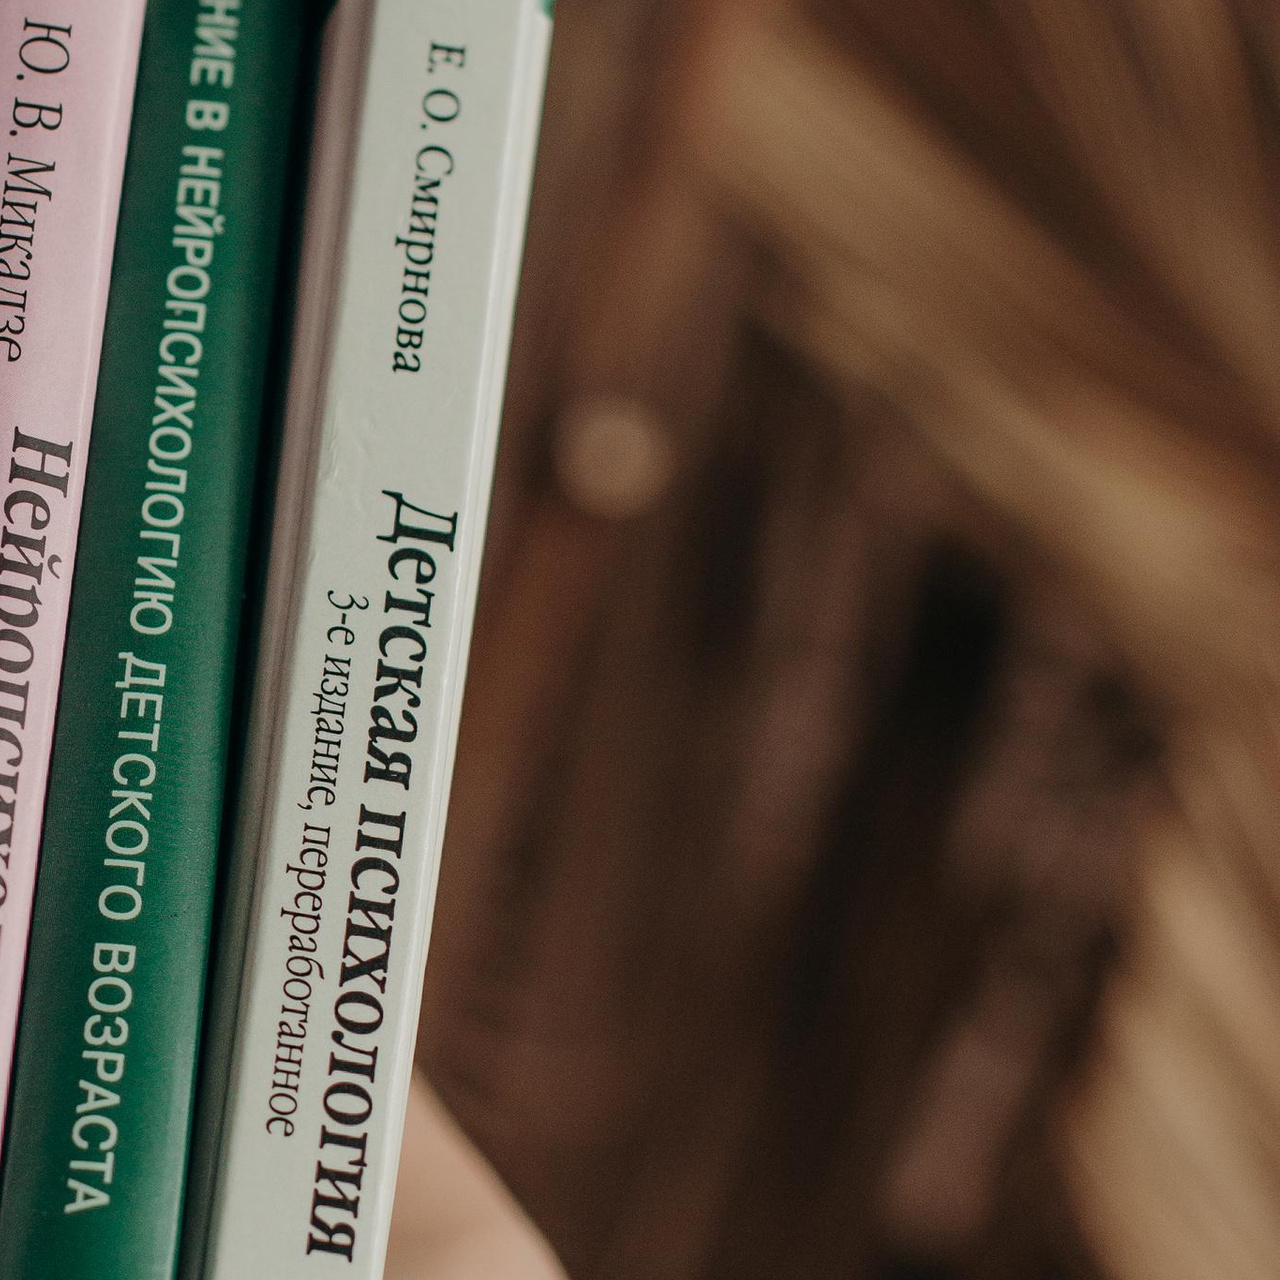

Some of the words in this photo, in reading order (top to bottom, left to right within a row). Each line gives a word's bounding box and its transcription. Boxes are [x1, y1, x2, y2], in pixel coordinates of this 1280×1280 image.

[9, 97, 63, 137] В.
[15, 17, 72, 81] Ю.
[185, 99, 230, 131] В
[421, 88, 460, 130] О.
[427, 41, 466, 73] Е.
[392, 145, 452, 373] Смирнова
[129, 145, 224, 636] НЕЙРОПСИХОЛОГИЮ
[326, 589, 370, 646] 3-е
[363, 489, 458, 791] Детская
[98, 651, 167, 921] ДЕТСКОГО
[297, 654, 352, 811] издание,
[265, 822, 331, 1138] переработанное
[306, 803, 407, 1263] психология
[64, 942, 137, 1214] ВОЗРАСТА
